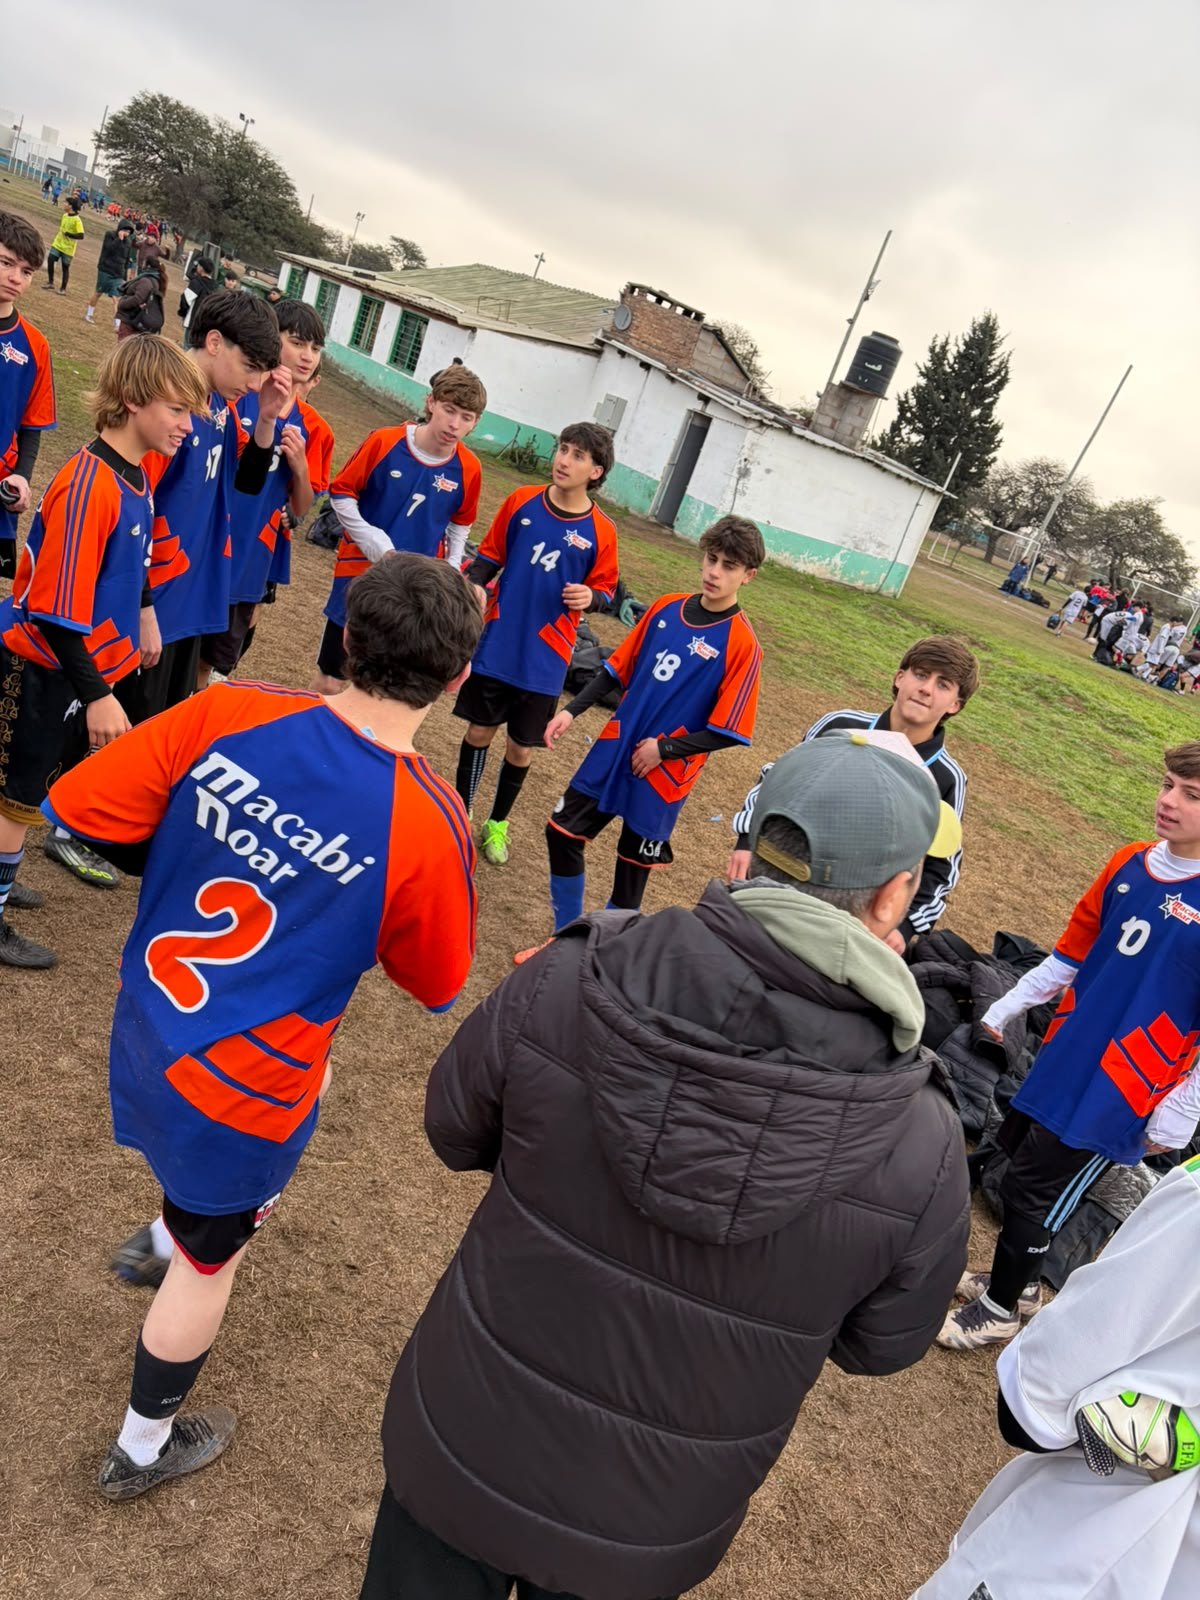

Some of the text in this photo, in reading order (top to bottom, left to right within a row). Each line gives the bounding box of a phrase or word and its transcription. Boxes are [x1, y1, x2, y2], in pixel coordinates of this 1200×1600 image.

[406, 492, 427, 517] 7
[530, 541, 561, 573] 14
[651, 648, 681, 681] 18
[190, 751, 376, 886] Macabi
[144, 876, 278, 1014] 2
[1115, 915, 1152, 957] 10
[1179, 1441, 1196, 1469] EFA
